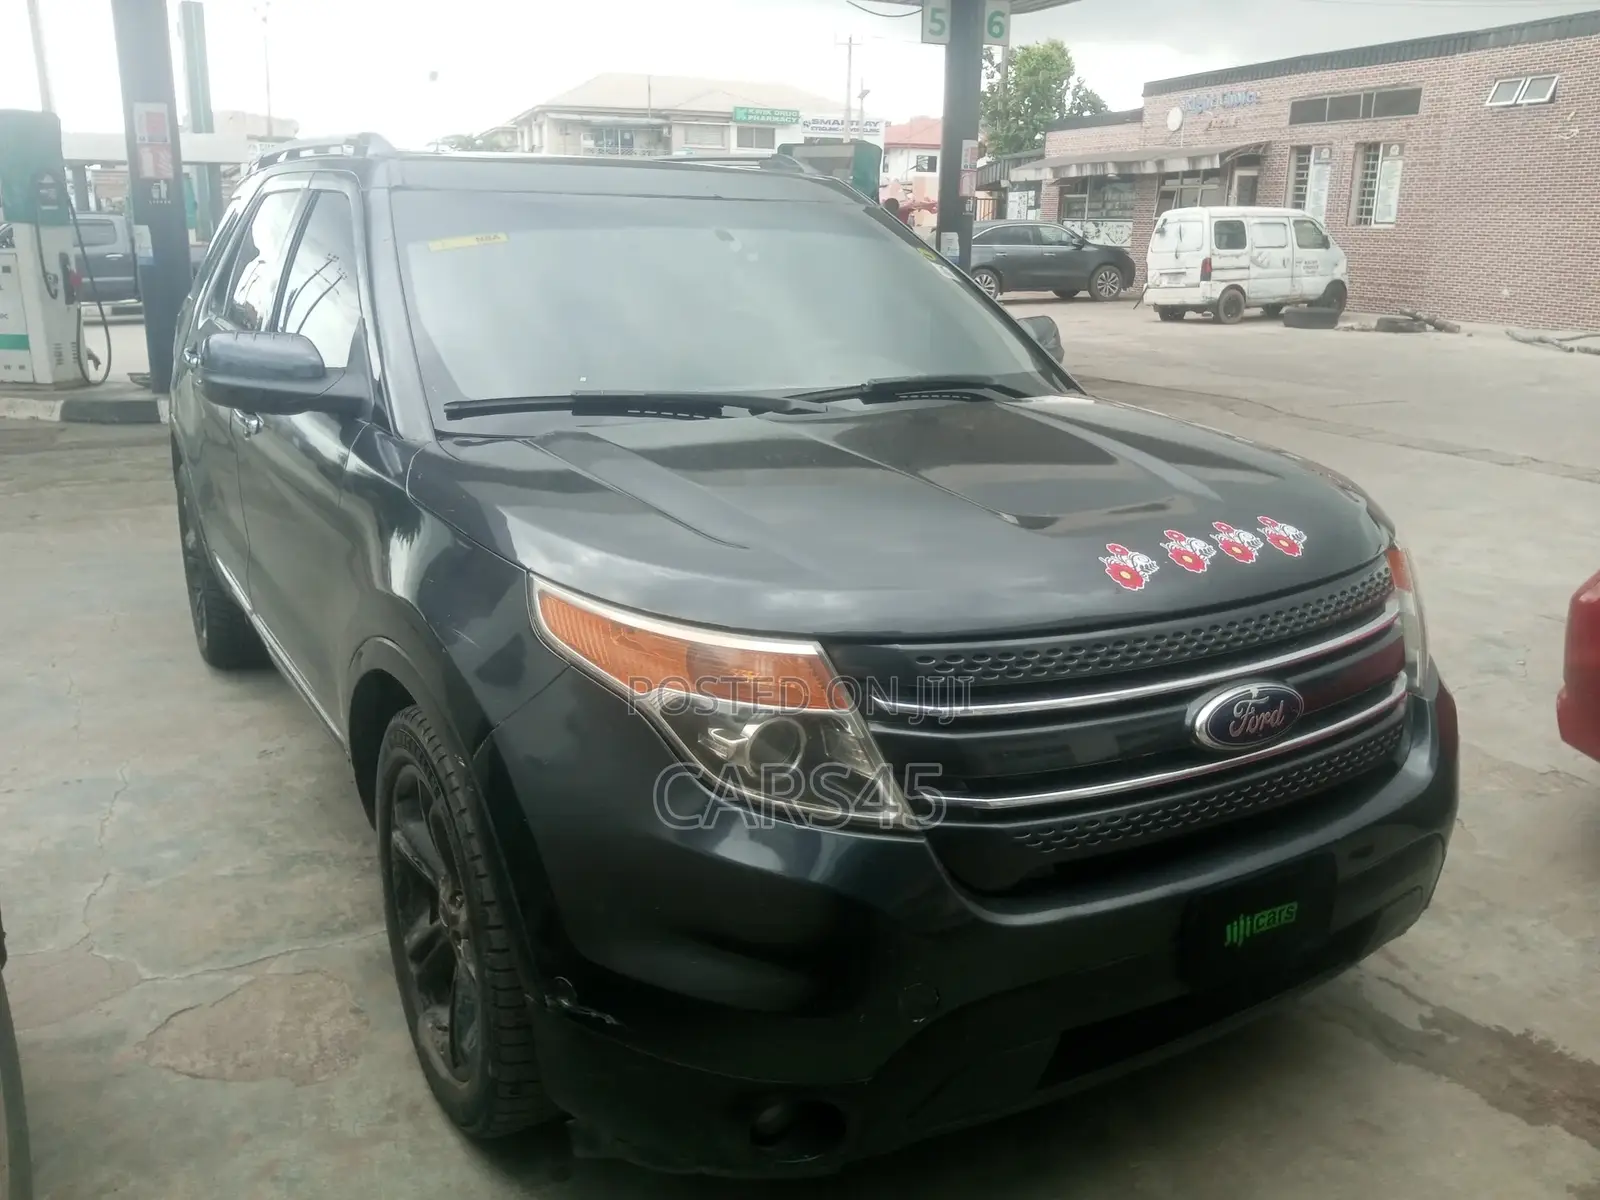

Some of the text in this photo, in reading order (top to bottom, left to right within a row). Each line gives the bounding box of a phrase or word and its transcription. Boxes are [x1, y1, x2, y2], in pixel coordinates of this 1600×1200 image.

[928, 7, 946, 37] 5
[986, 9, 1006, 39] 6
[747, 115, 798, 123] PHARMACY
[811, 118, 880, 128] SMATAY
[1229, 694, 1285, 737] Ford
